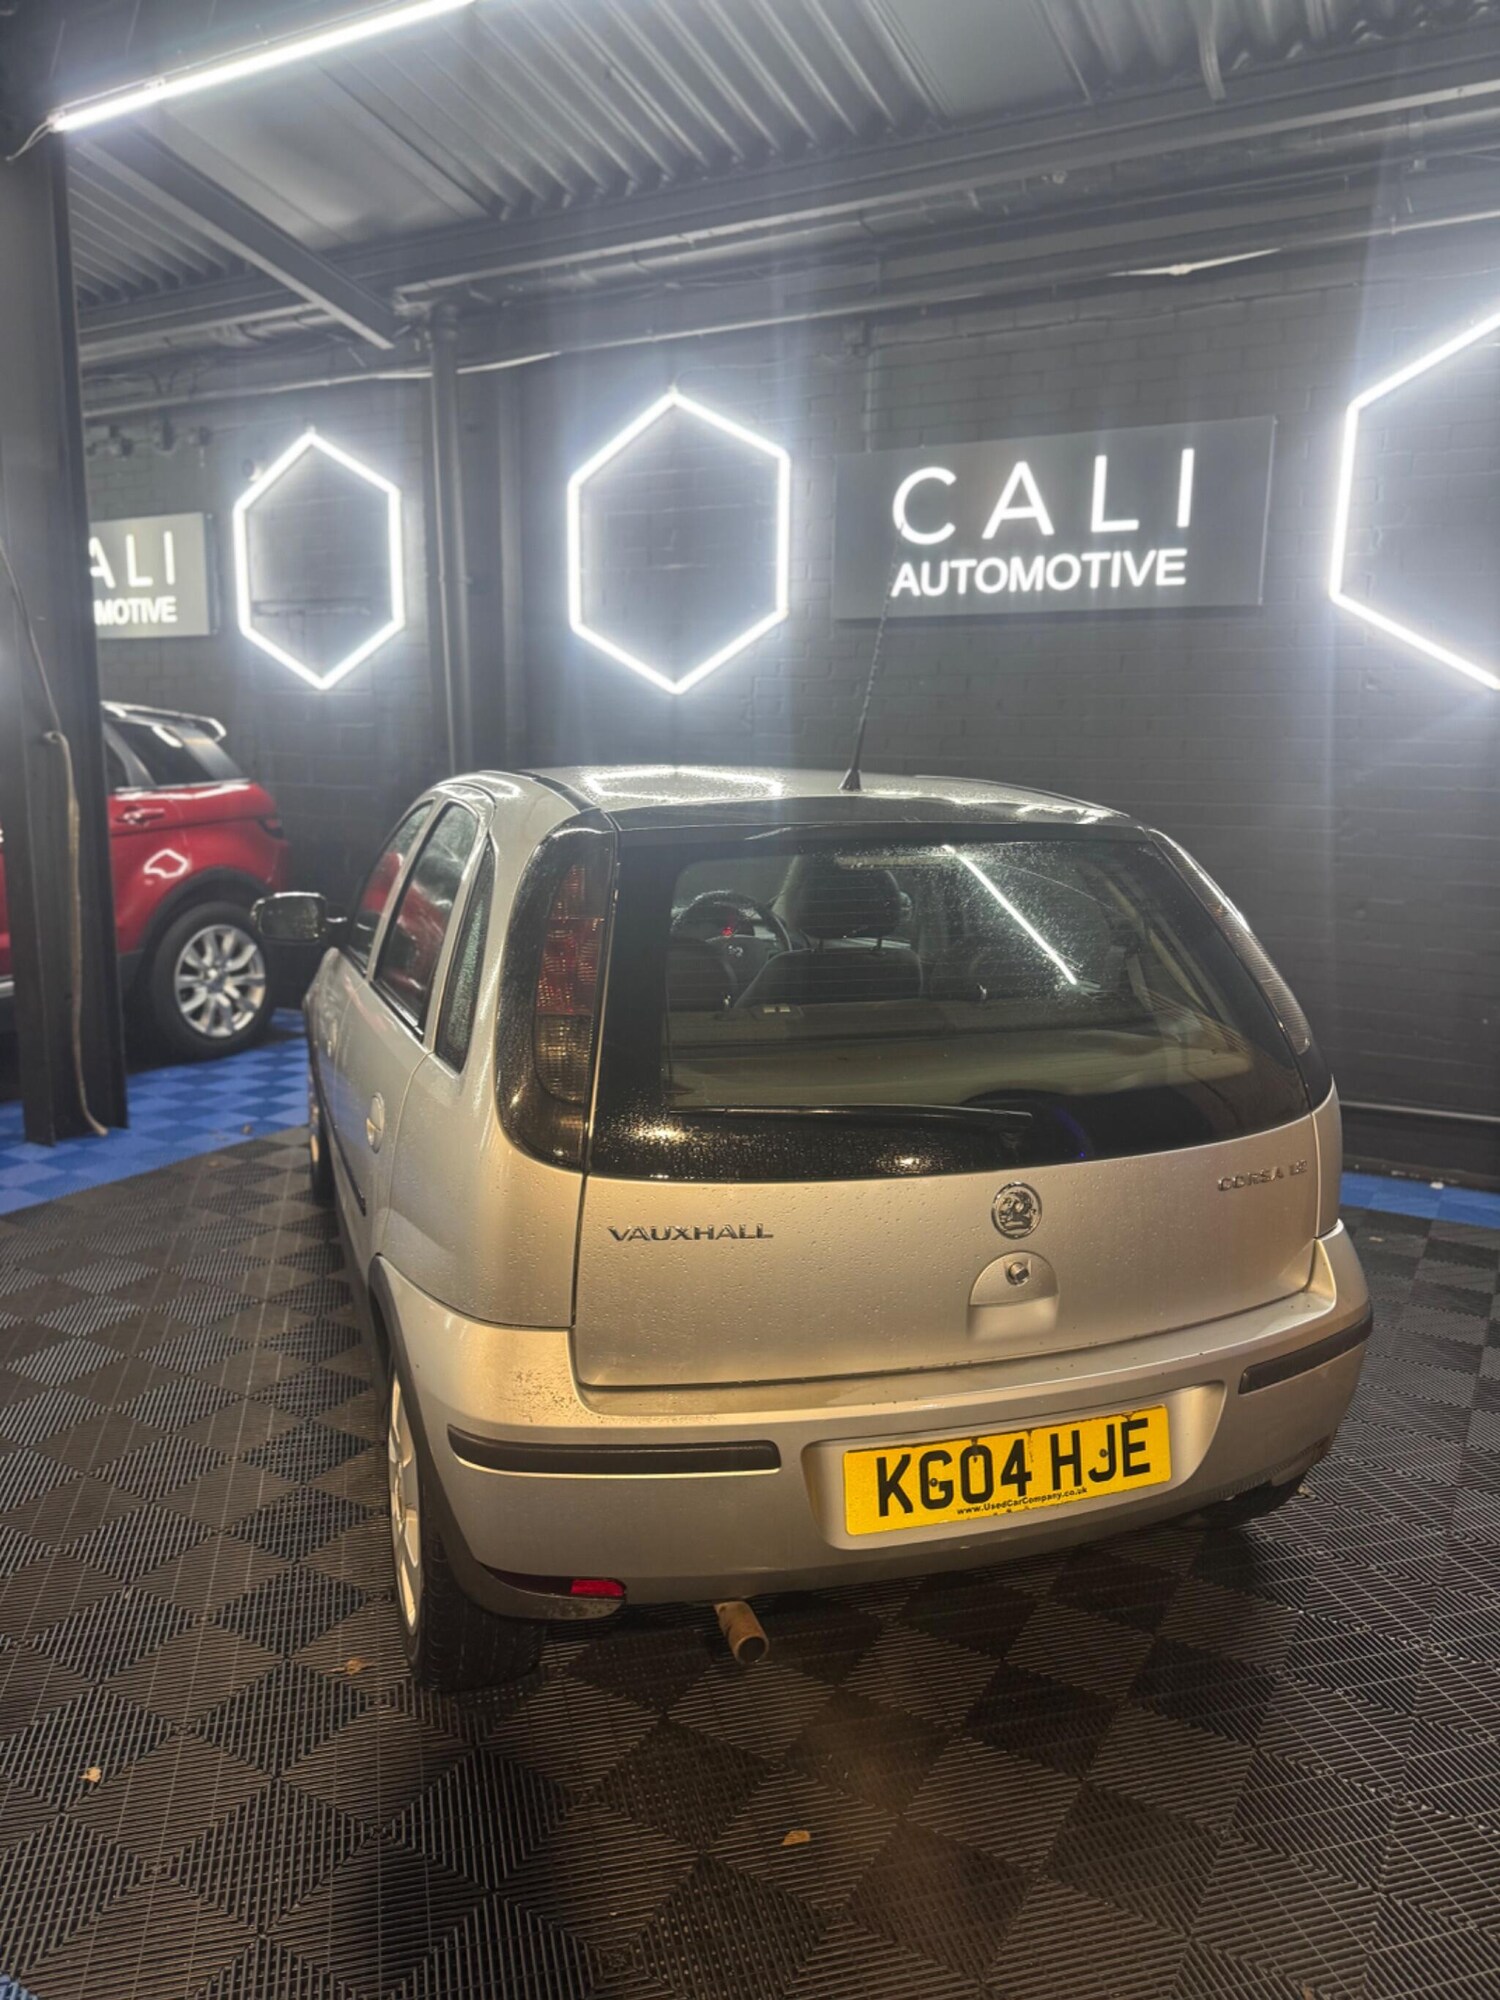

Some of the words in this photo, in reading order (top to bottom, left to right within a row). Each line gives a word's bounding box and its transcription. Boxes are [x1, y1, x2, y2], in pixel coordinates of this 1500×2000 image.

[892, 448, 1194, 545] CALI
[88, 530, 176, 589] ALI
[891, 548, 1188, 597] AUTOMOTIVE
[93, 596, 178, 626] MOTIVE
[607, 1224, 773, 1241] VAUXHALL
[876, 1438, 1032, 1517] KG04
[1050, 1417, 1151, 1491] HJE
[956, 1486, 1088, 1516] www.UsedCarCompany.co.uk
